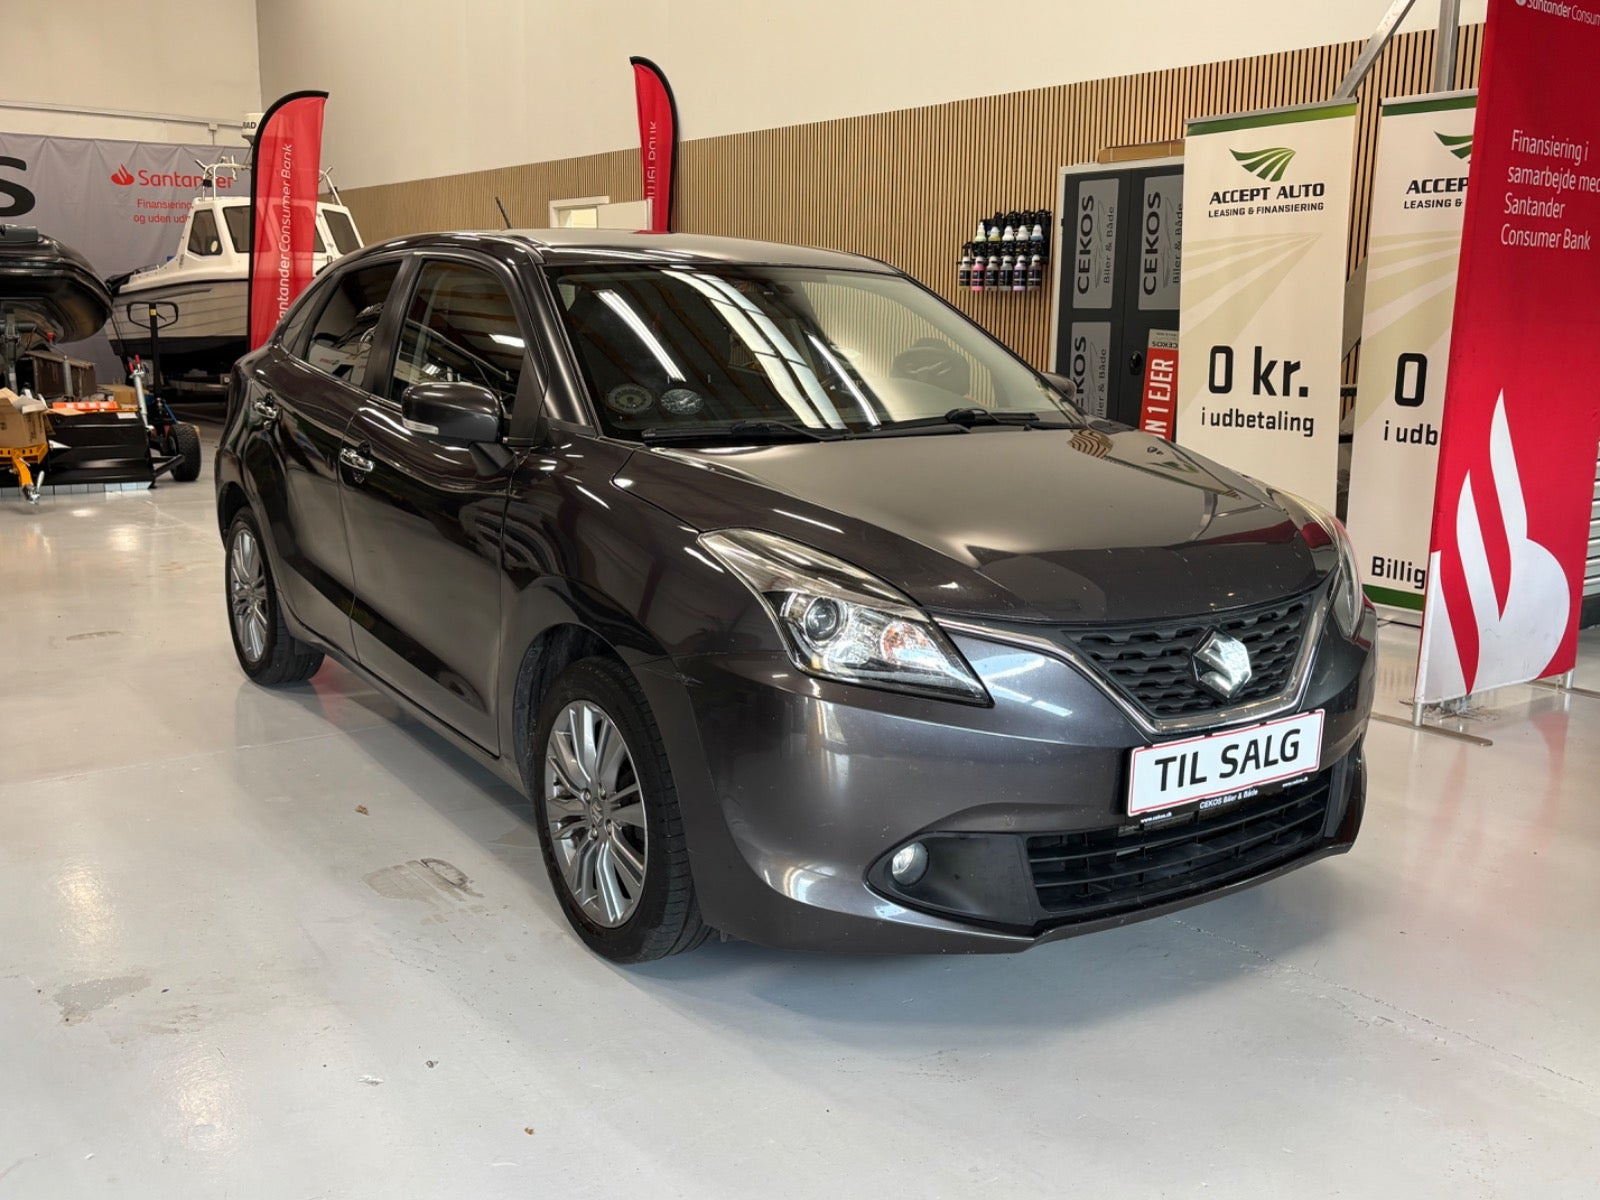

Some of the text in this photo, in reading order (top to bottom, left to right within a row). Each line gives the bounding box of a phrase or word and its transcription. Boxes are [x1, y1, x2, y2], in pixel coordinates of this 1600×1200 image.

[280, 144, 293, 179] Bank
[1511, 129, 1589, 166] Finansiering i
[1209, 182, 1325, 205] ACCEPT AUTO
[1507, 165, 1576, 194] samarbejde
[278, 180, 291, 252] Consumer
[1208, 202, 1324, 218] LEASING & FINANSIERING
[1404, 198, 1462, 209] LEASING &
[1504, 192, 1565, 218] Santander
[133, 214, 146, 225] og
[1106, 206, 1114, 237] Både
[1077, 195, 1094, 294] CEKOS
[1106, 242, 1112, 252] &
[1143, 191, 1161, 295] CEKOS
[1500, 223, 1591, 251] Consumer Bank
[1148, 358, 1174, 401] EJER
[1208, 345, 1309, 398] 0 kr.
[1394, 352, 1428, 407] 0
[1147, 406, 1169, 414] 1
[1201, 406, 1314, 437] i udbetaling
[1384, 419, 1439, 446] i udb
[1371, 555, 1426, 590] Billig
[1154, 728, 1301, 792] TIL SALG
[1199, 797, 1222, 809] CEKOS
